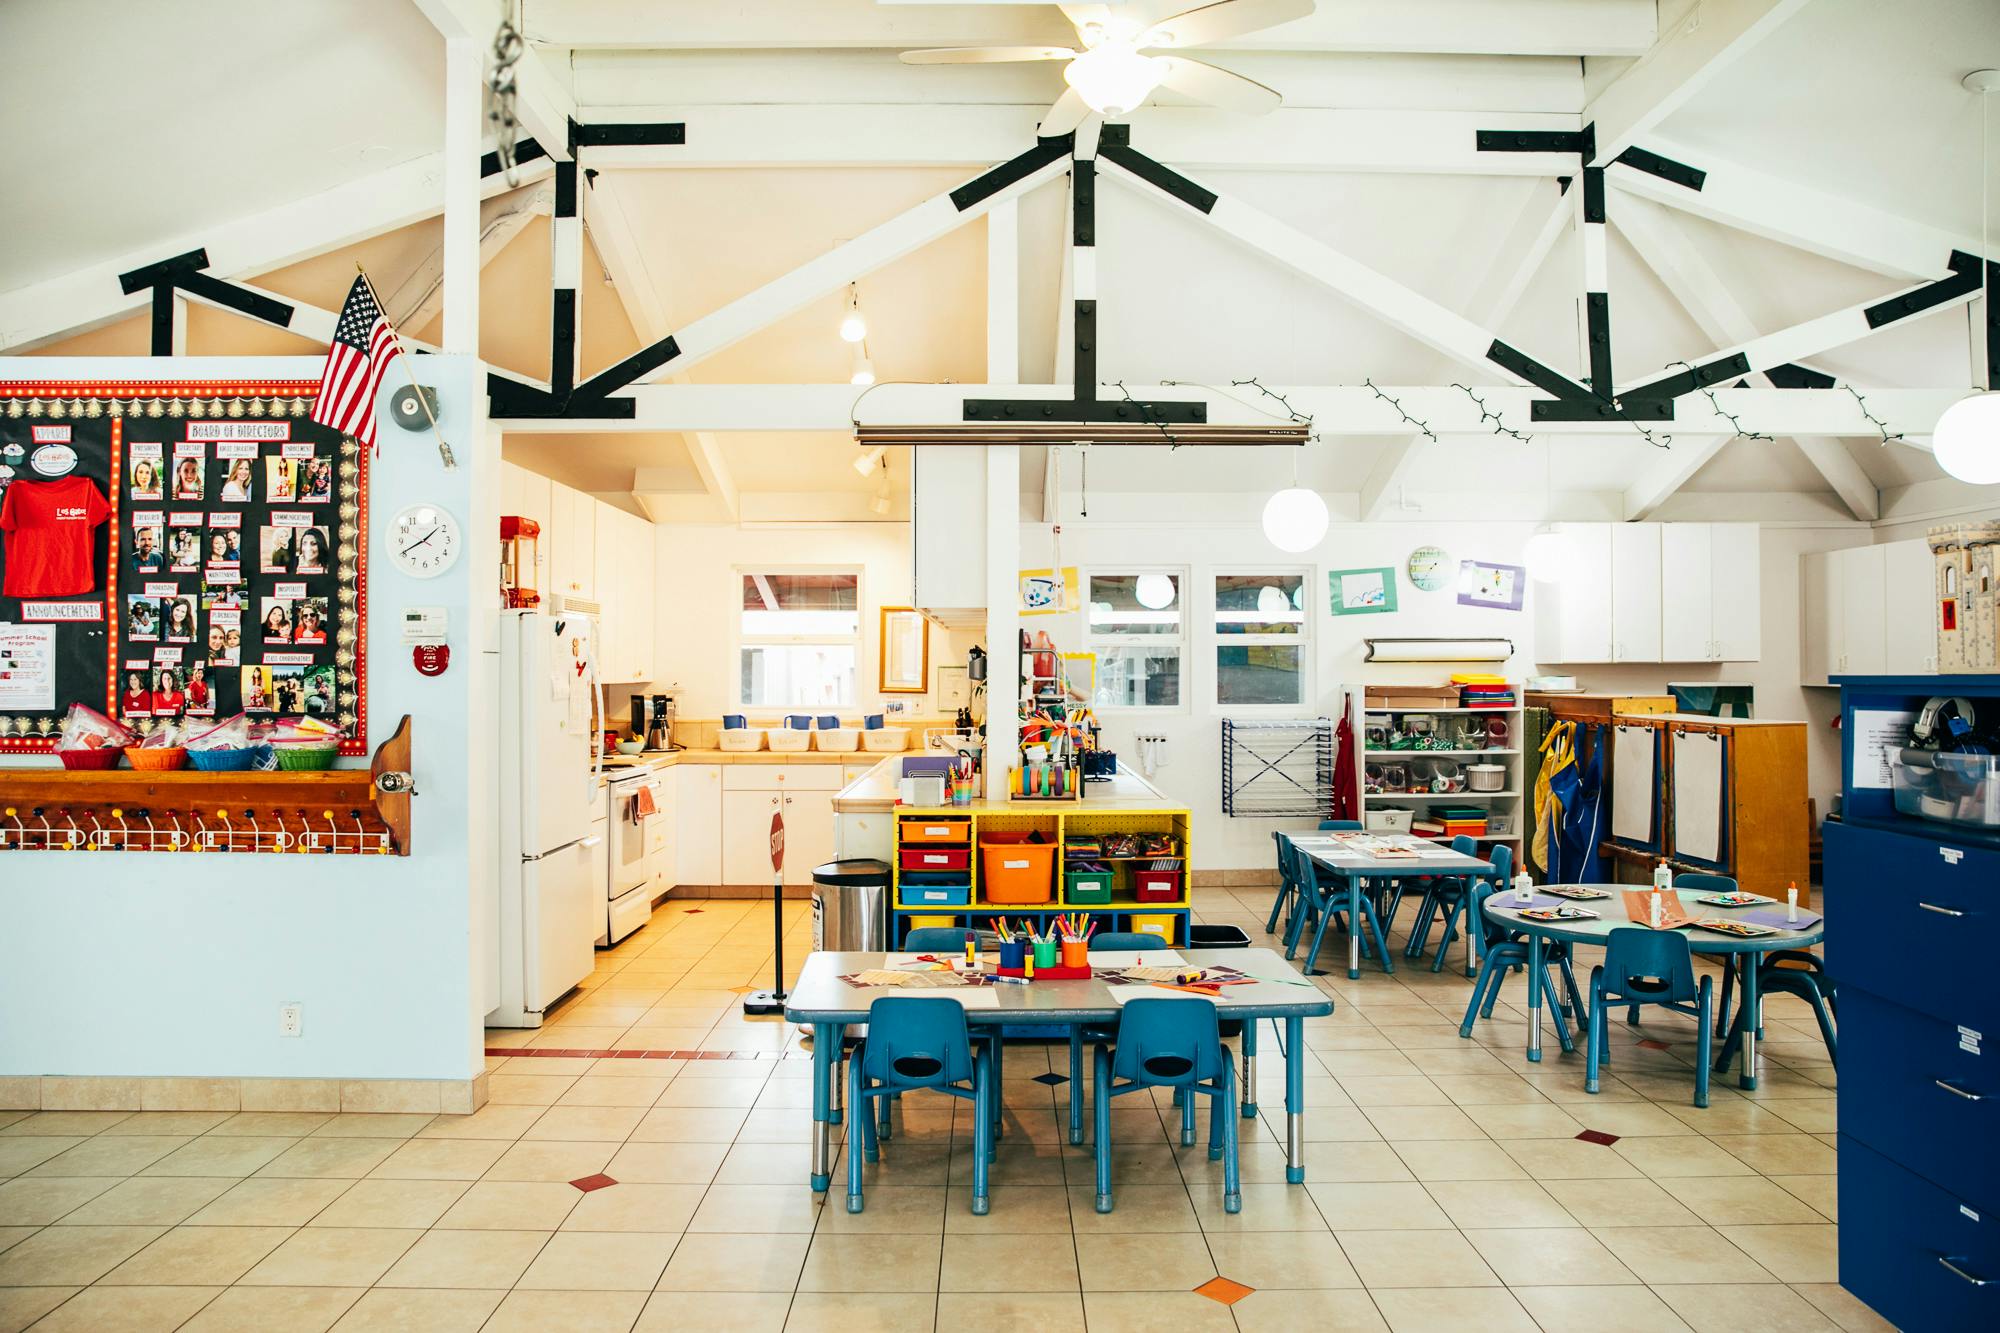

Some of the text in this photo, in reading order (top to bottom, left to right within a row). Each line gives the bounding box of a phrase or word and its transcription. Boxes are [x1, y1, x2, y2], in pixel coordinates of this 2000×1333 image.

[192, 425, 285, 438] BOARD OF DIRECTORS
[56, 508, 86, 517] Los Gatos
[409, 517, 416, 525] 11
[400, 526, 409, 534] 10
[441, 524, 447, 533] 2
[446, 536, 451, 545] 3
[411, 557, 416, 566] 7
[434, 556, 440, 566] 5
[27, 605, 98, 618] ANNOUNCEMENTS
[771, 829, 784, 855] STOP
